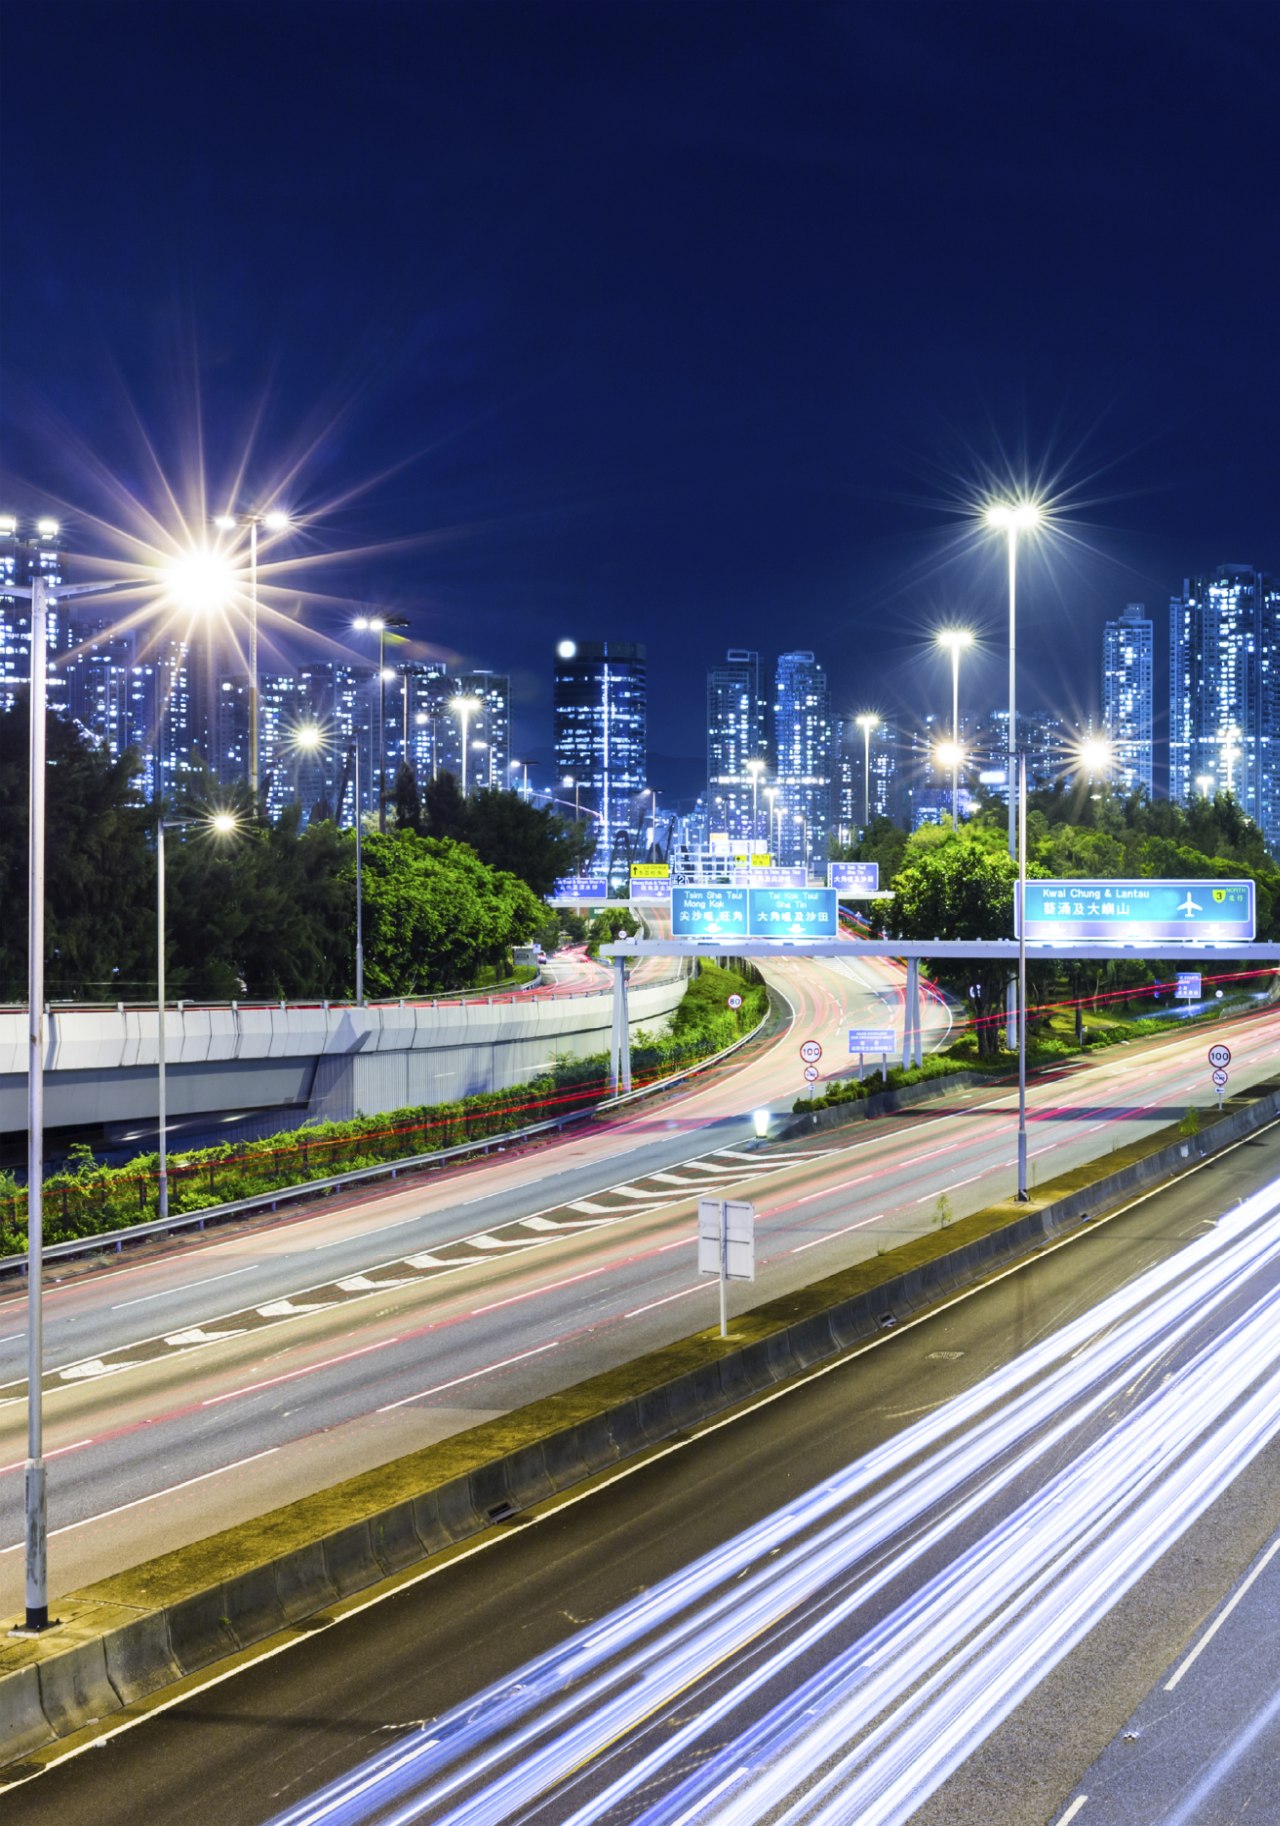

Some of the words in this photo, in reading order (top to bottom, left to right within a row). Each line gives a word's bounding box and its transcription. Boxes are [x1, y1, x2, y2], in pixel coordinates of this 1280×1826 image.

[685, 891, 702, 899] Tsim
[706, 891, 722, 899] Sha
[726, 891, 743, 899] Tsui
[1042, 888, 1066, 898] Kwai
[1070, 888, 1101, 900] Chung
[1104, 888, 1112, 898] &
[1116, 889, 1150, 898] Lantau
[1216, 892, 1222, 900] 3
[684, 900, 706, 909] Mong
[1211, 1052, 1229, 1061] 100
